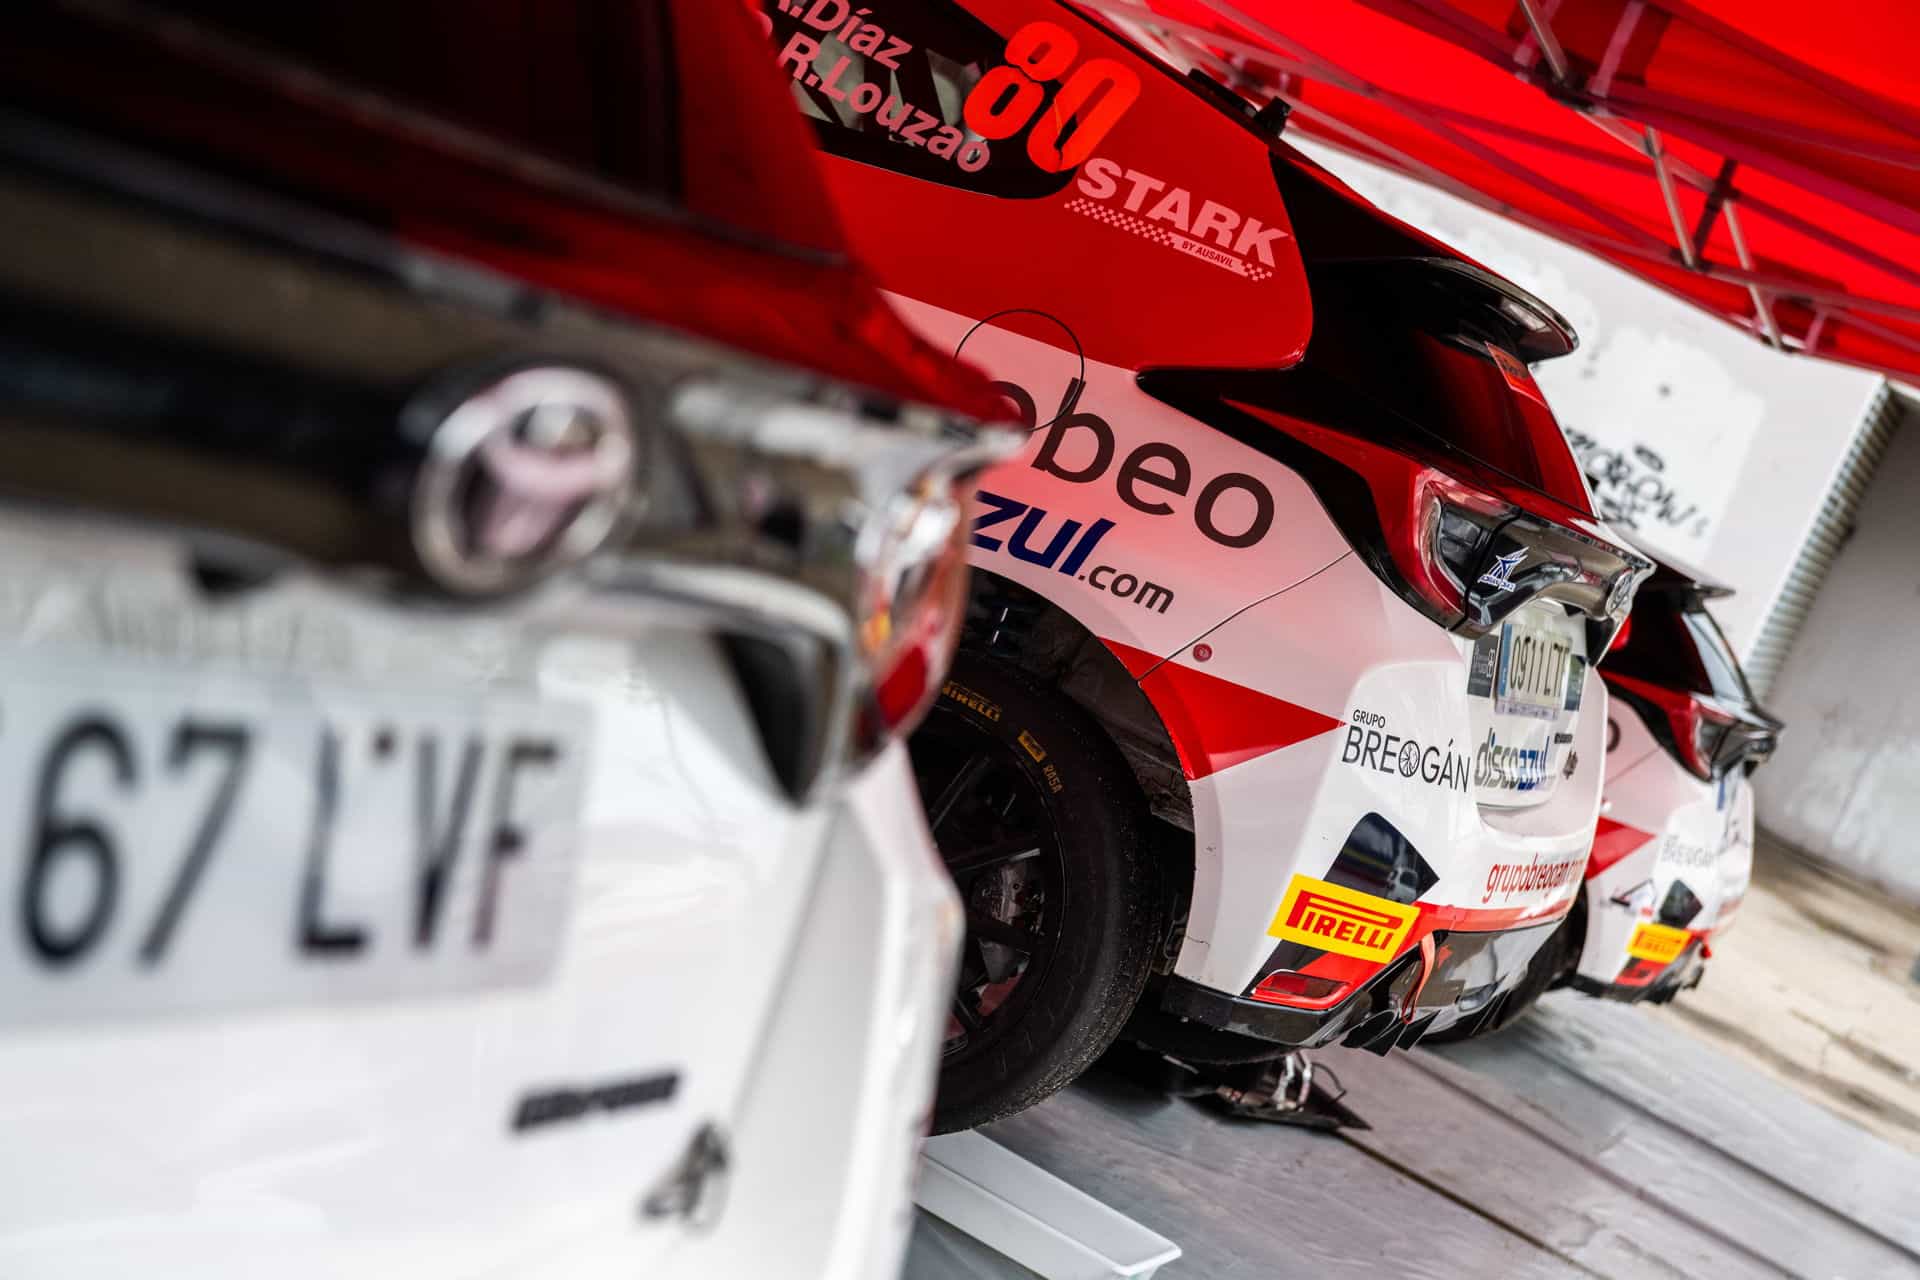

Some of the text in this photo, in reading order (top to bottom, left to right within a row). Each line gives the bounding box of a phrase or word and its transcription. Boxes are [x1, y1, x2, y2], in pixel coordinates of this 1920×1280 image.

[776, 31, 990, 173] R.Louzao
[964, 20, 1142, 174] 80
[1077, 157, 1289, 268] STARK
[1181, 240, 1234, 268] BY AUSAVIL
[1352, 709, 1386, 729] GRUPO
[1341, 724, 1471, 793] BREOGÁN
[1285, 889, 1404, 951] PIRELLI
